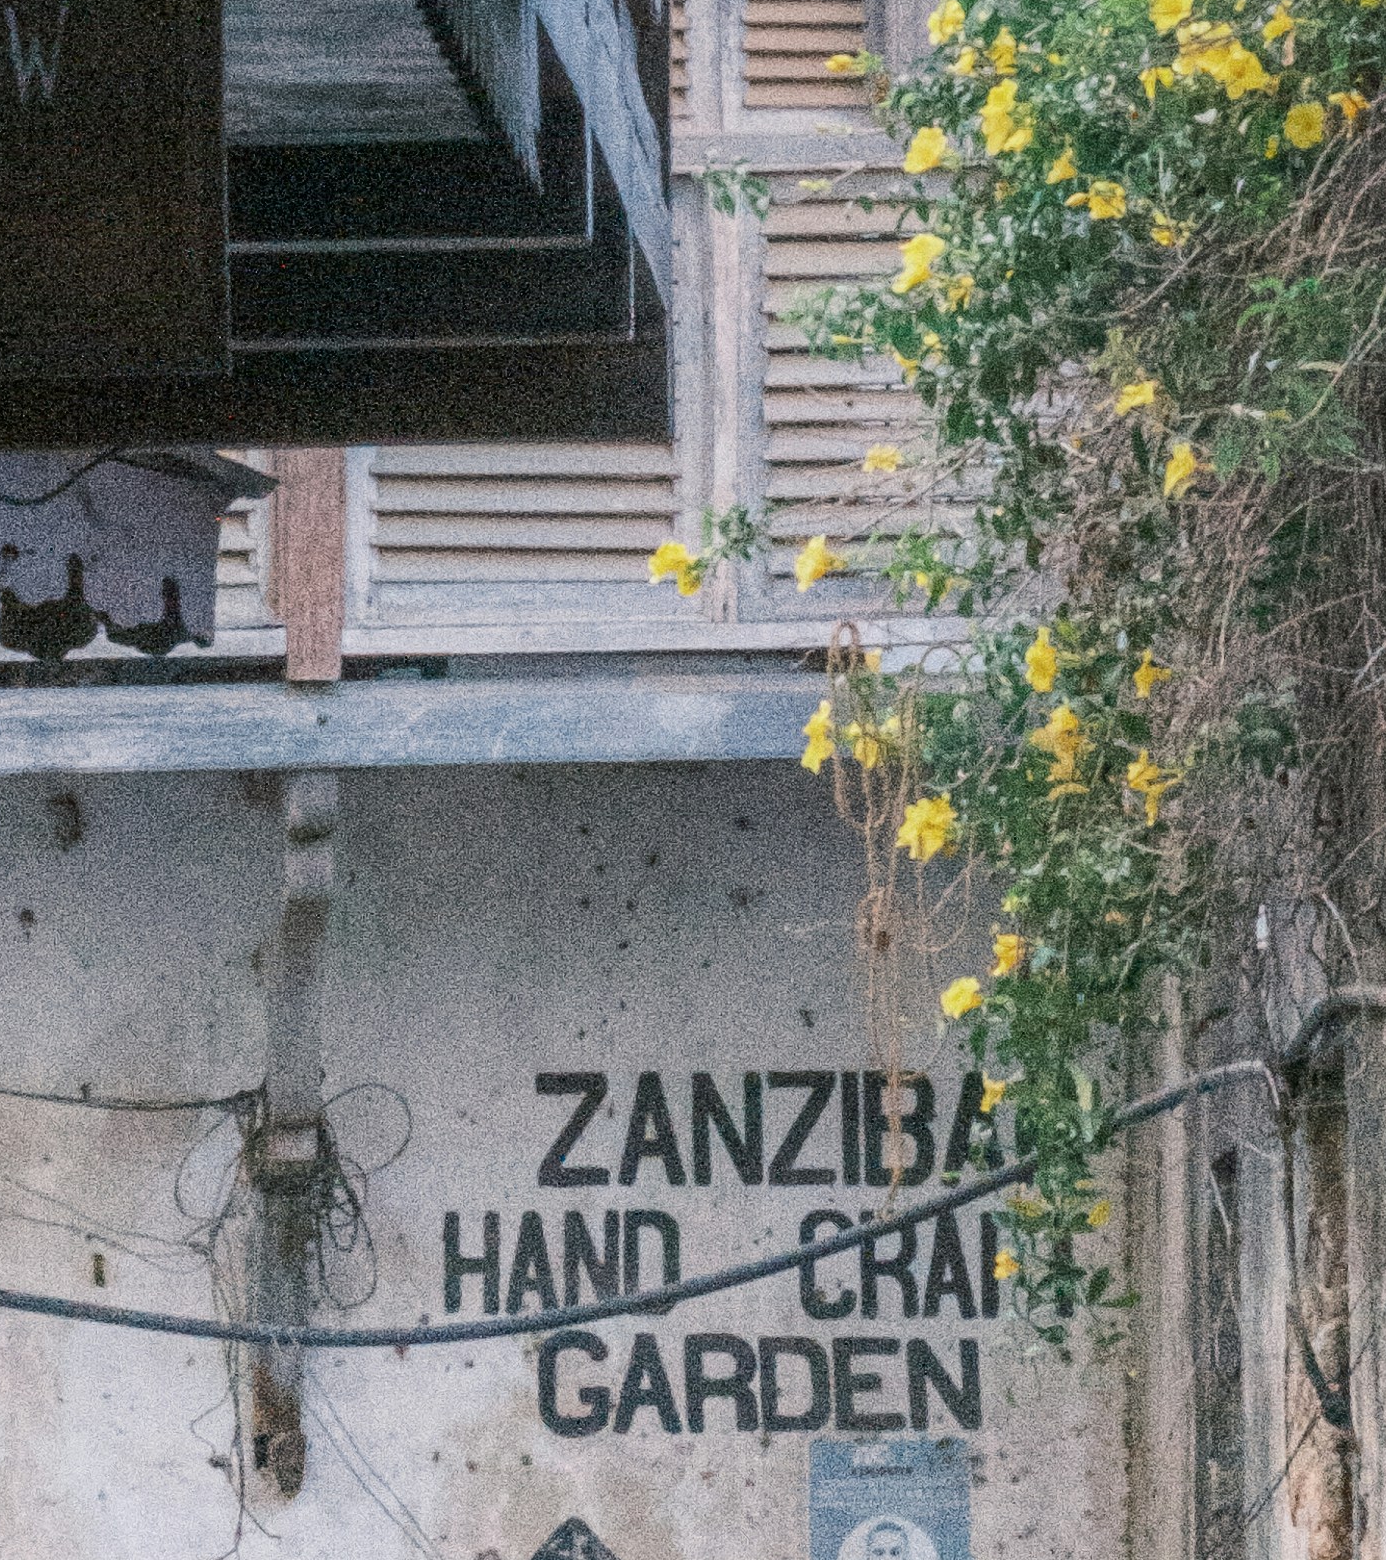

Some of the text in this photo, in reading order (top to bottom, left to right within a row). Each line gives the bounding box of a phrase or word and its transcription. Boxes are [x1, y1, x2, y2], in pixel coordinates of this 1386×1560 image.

[535, 1070, 1039, 1187] ZANZIBA
[443, 1209, 680, 1315] HAND
[536, 1328, 983, 1437] GARDEN
